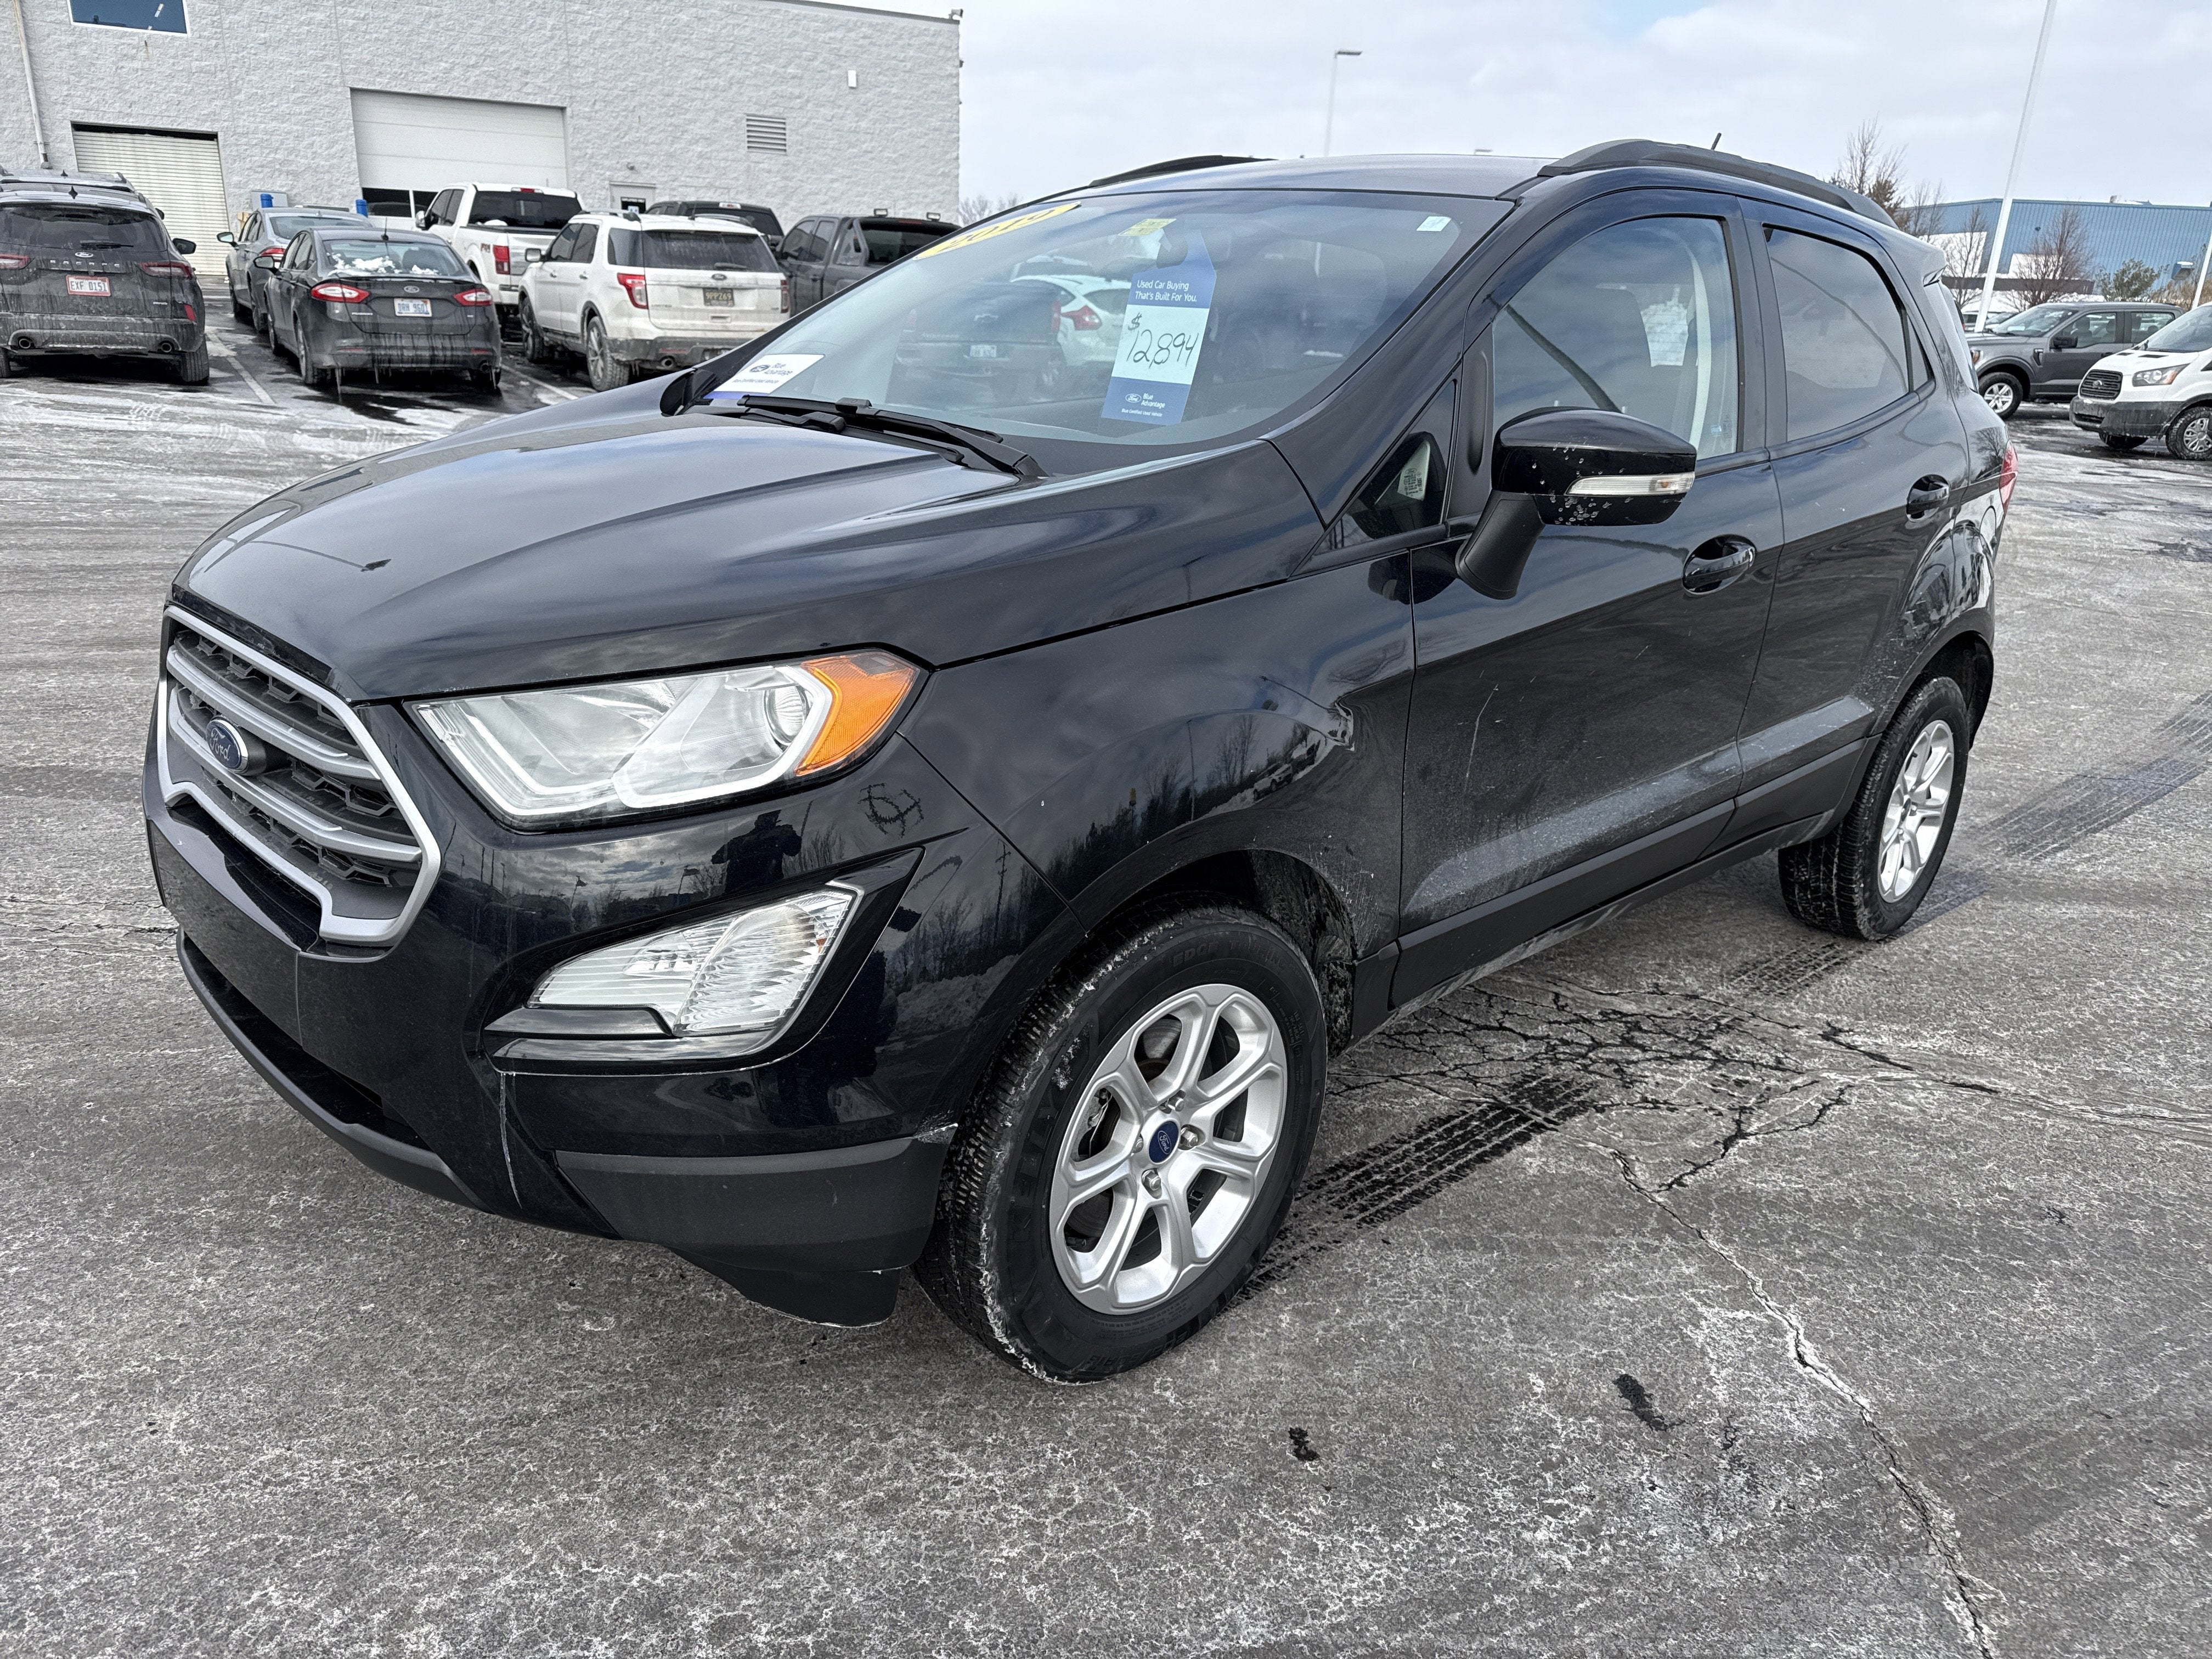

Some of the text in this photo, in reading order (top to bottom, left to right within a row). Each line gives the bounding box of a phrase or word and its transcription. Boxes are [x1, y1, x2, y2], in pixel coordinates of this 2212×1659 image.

[936, 209, 1056, 253] 2019
[70, 281, 108, 291] EXF 0151
[1137, 280, 1189, 292] Used Car Buying
[1135, 291, 1197, 302] That's Built For You.
[1141, 399, 1166, 409] Advantage
[209, 727, 232, 761] Ford
